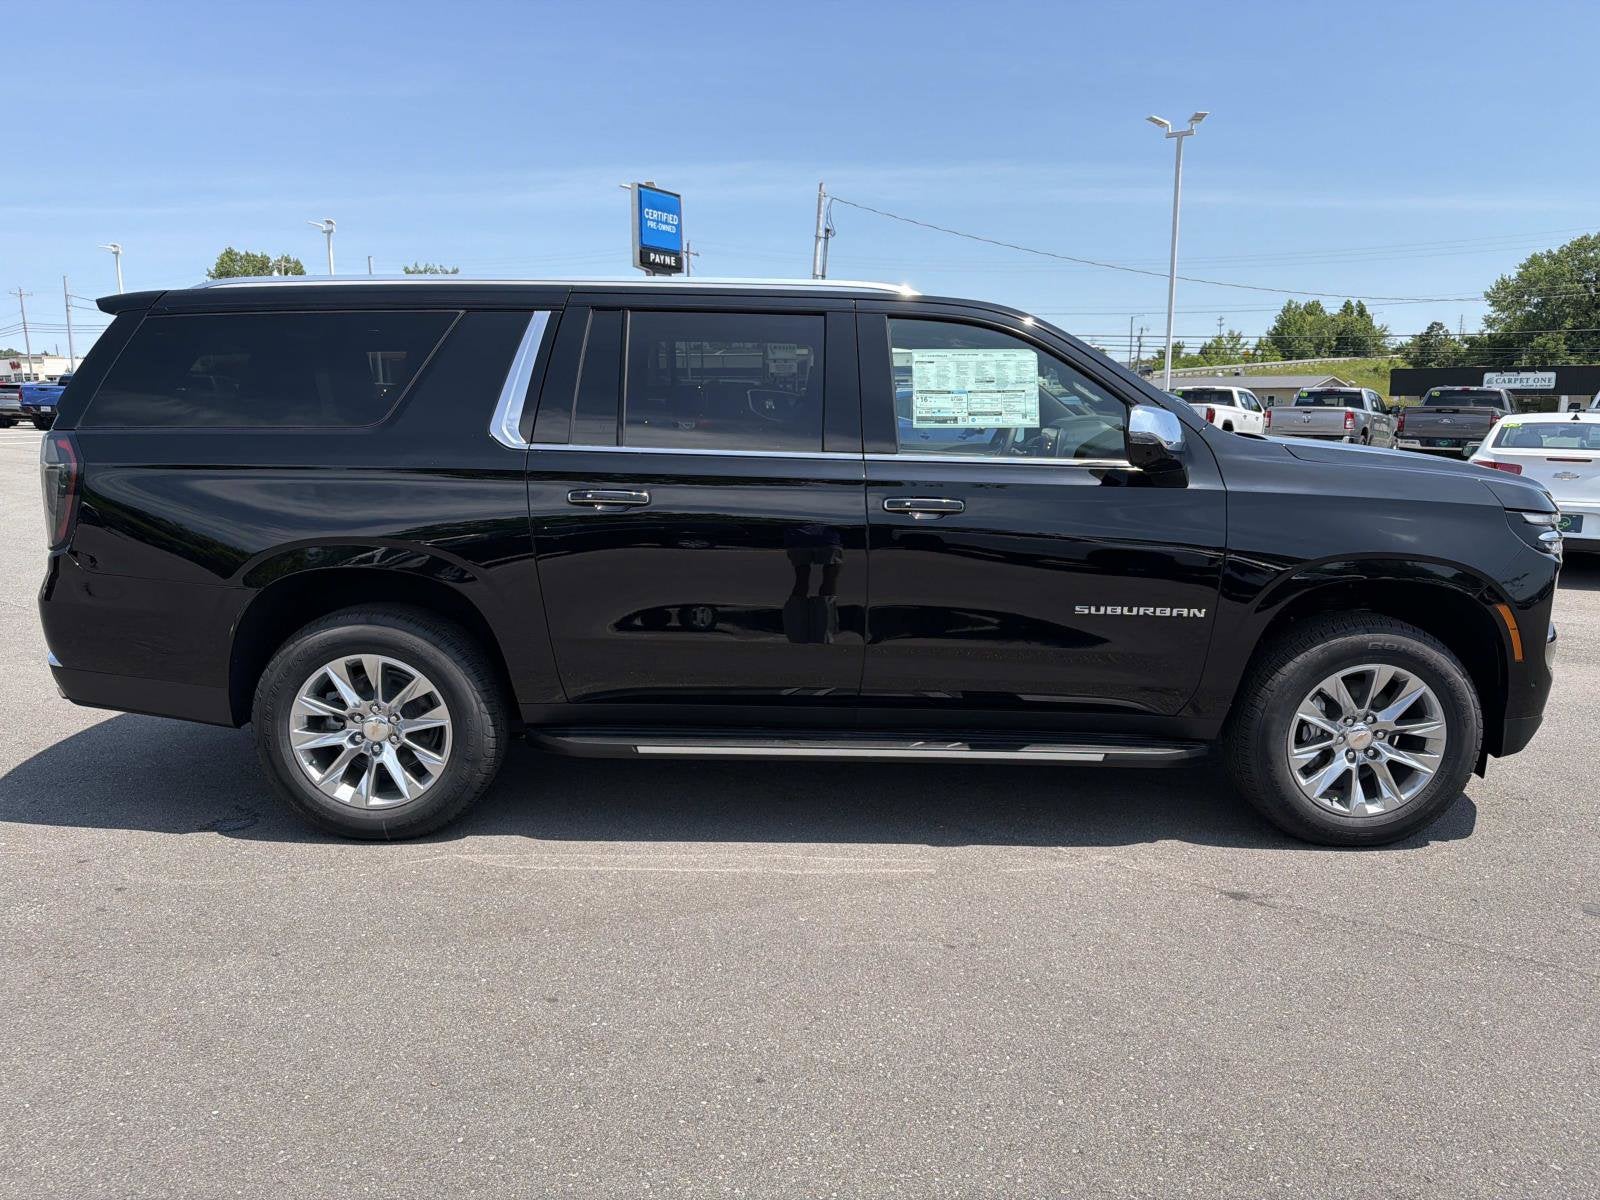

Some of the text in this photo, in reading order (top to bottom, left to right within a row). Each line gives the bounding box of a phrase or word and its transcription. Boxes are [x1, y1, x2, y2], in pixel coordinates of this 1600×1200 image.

[644, 208, 678, 225] CERTIFIED
[647, 220, 676, 233] PRE-OWNED
[650, 253, 676, 266] PAYNE
[1074, 605, 1206, 618] SUBURBAN
